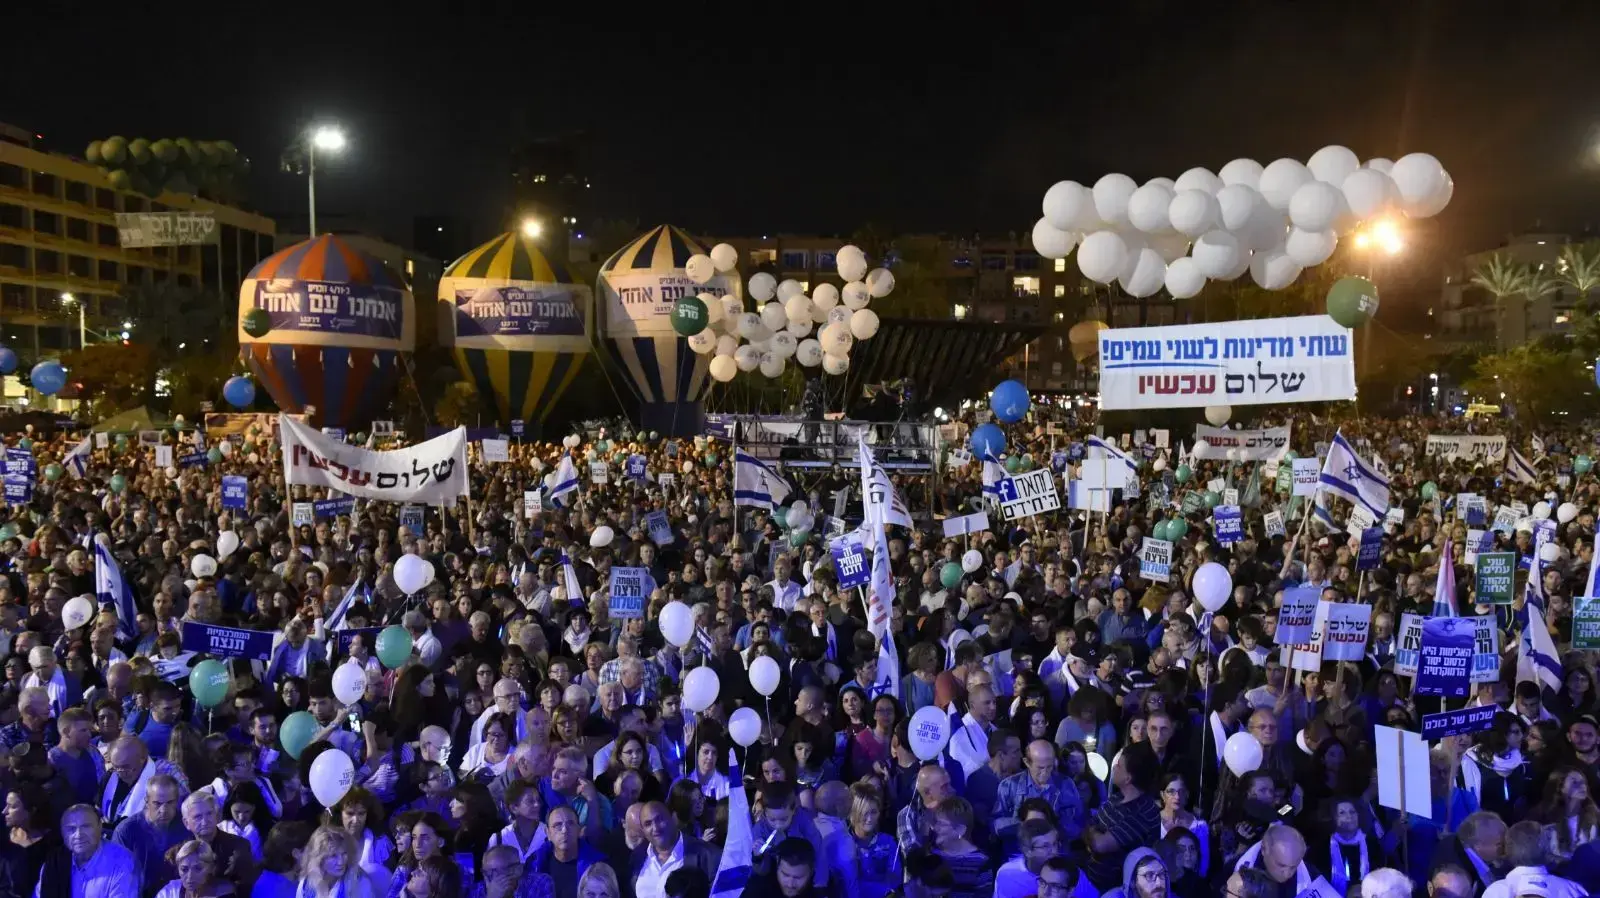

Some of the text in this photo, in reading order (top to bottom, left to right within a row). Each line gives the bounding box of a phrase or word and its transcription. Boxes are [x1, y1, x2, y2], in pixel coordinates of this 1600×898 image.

[619, 286, 653, 305] אחד!
[259, 290, 396, 320] אנחנו עם אחד!
[471, 301, 575, 318] אנחנו עם אחד!
[1102, 334, 1348, 361] שתי מדינות לשני עמים!
[1138, 361, 1306, 394] שלום עכשיו
[1246, 432, 1287, 448] שלום
[293, 444, 456, 489] שלום עכשיו
[1294, 465, 1318, 477] שלום
[1015, 470, 1055, 499] מחאת
[1294, 476, 1318, 485] עכשיו
[1003, 494, 1059, 519] היחידים
[843, 546, 853, 558] זה
[1145, 552, 1168, 564] הרצח
[837, 553, 863, 568] מתחיל
[1487, 558, 1506, 566] שני
[616, 577, 641, 585] ההסתה
[1480, 576, 1511, 585] תקווה
[614, 585, 642, 597] הרצח
[1482, 585, 1508, 593] אחת
[1281, 600, 1315, 614] שלום
[1280, 616, 1312, 626] עכשיו
[1329, 615, 1367, 631] שלום
[206, 627, 251, 640] הממלכתיות
[1328, 632, 1365, 643] עכשיו
[210, 636, 245, 650] תנצח
[1422, 646, 1472, 657] האלימות היא
[1425, 656, 1441, 666] יסוד
[1444, 657, 1467, 667] כרסום
[1423, 666, 1466, 676] הדמוקרטיה
[1425, 710, 1494, 730] שלום של כולם
[920, 723, 939, 733] אנחנו
[916, 729, 941, 741] עם אחד
